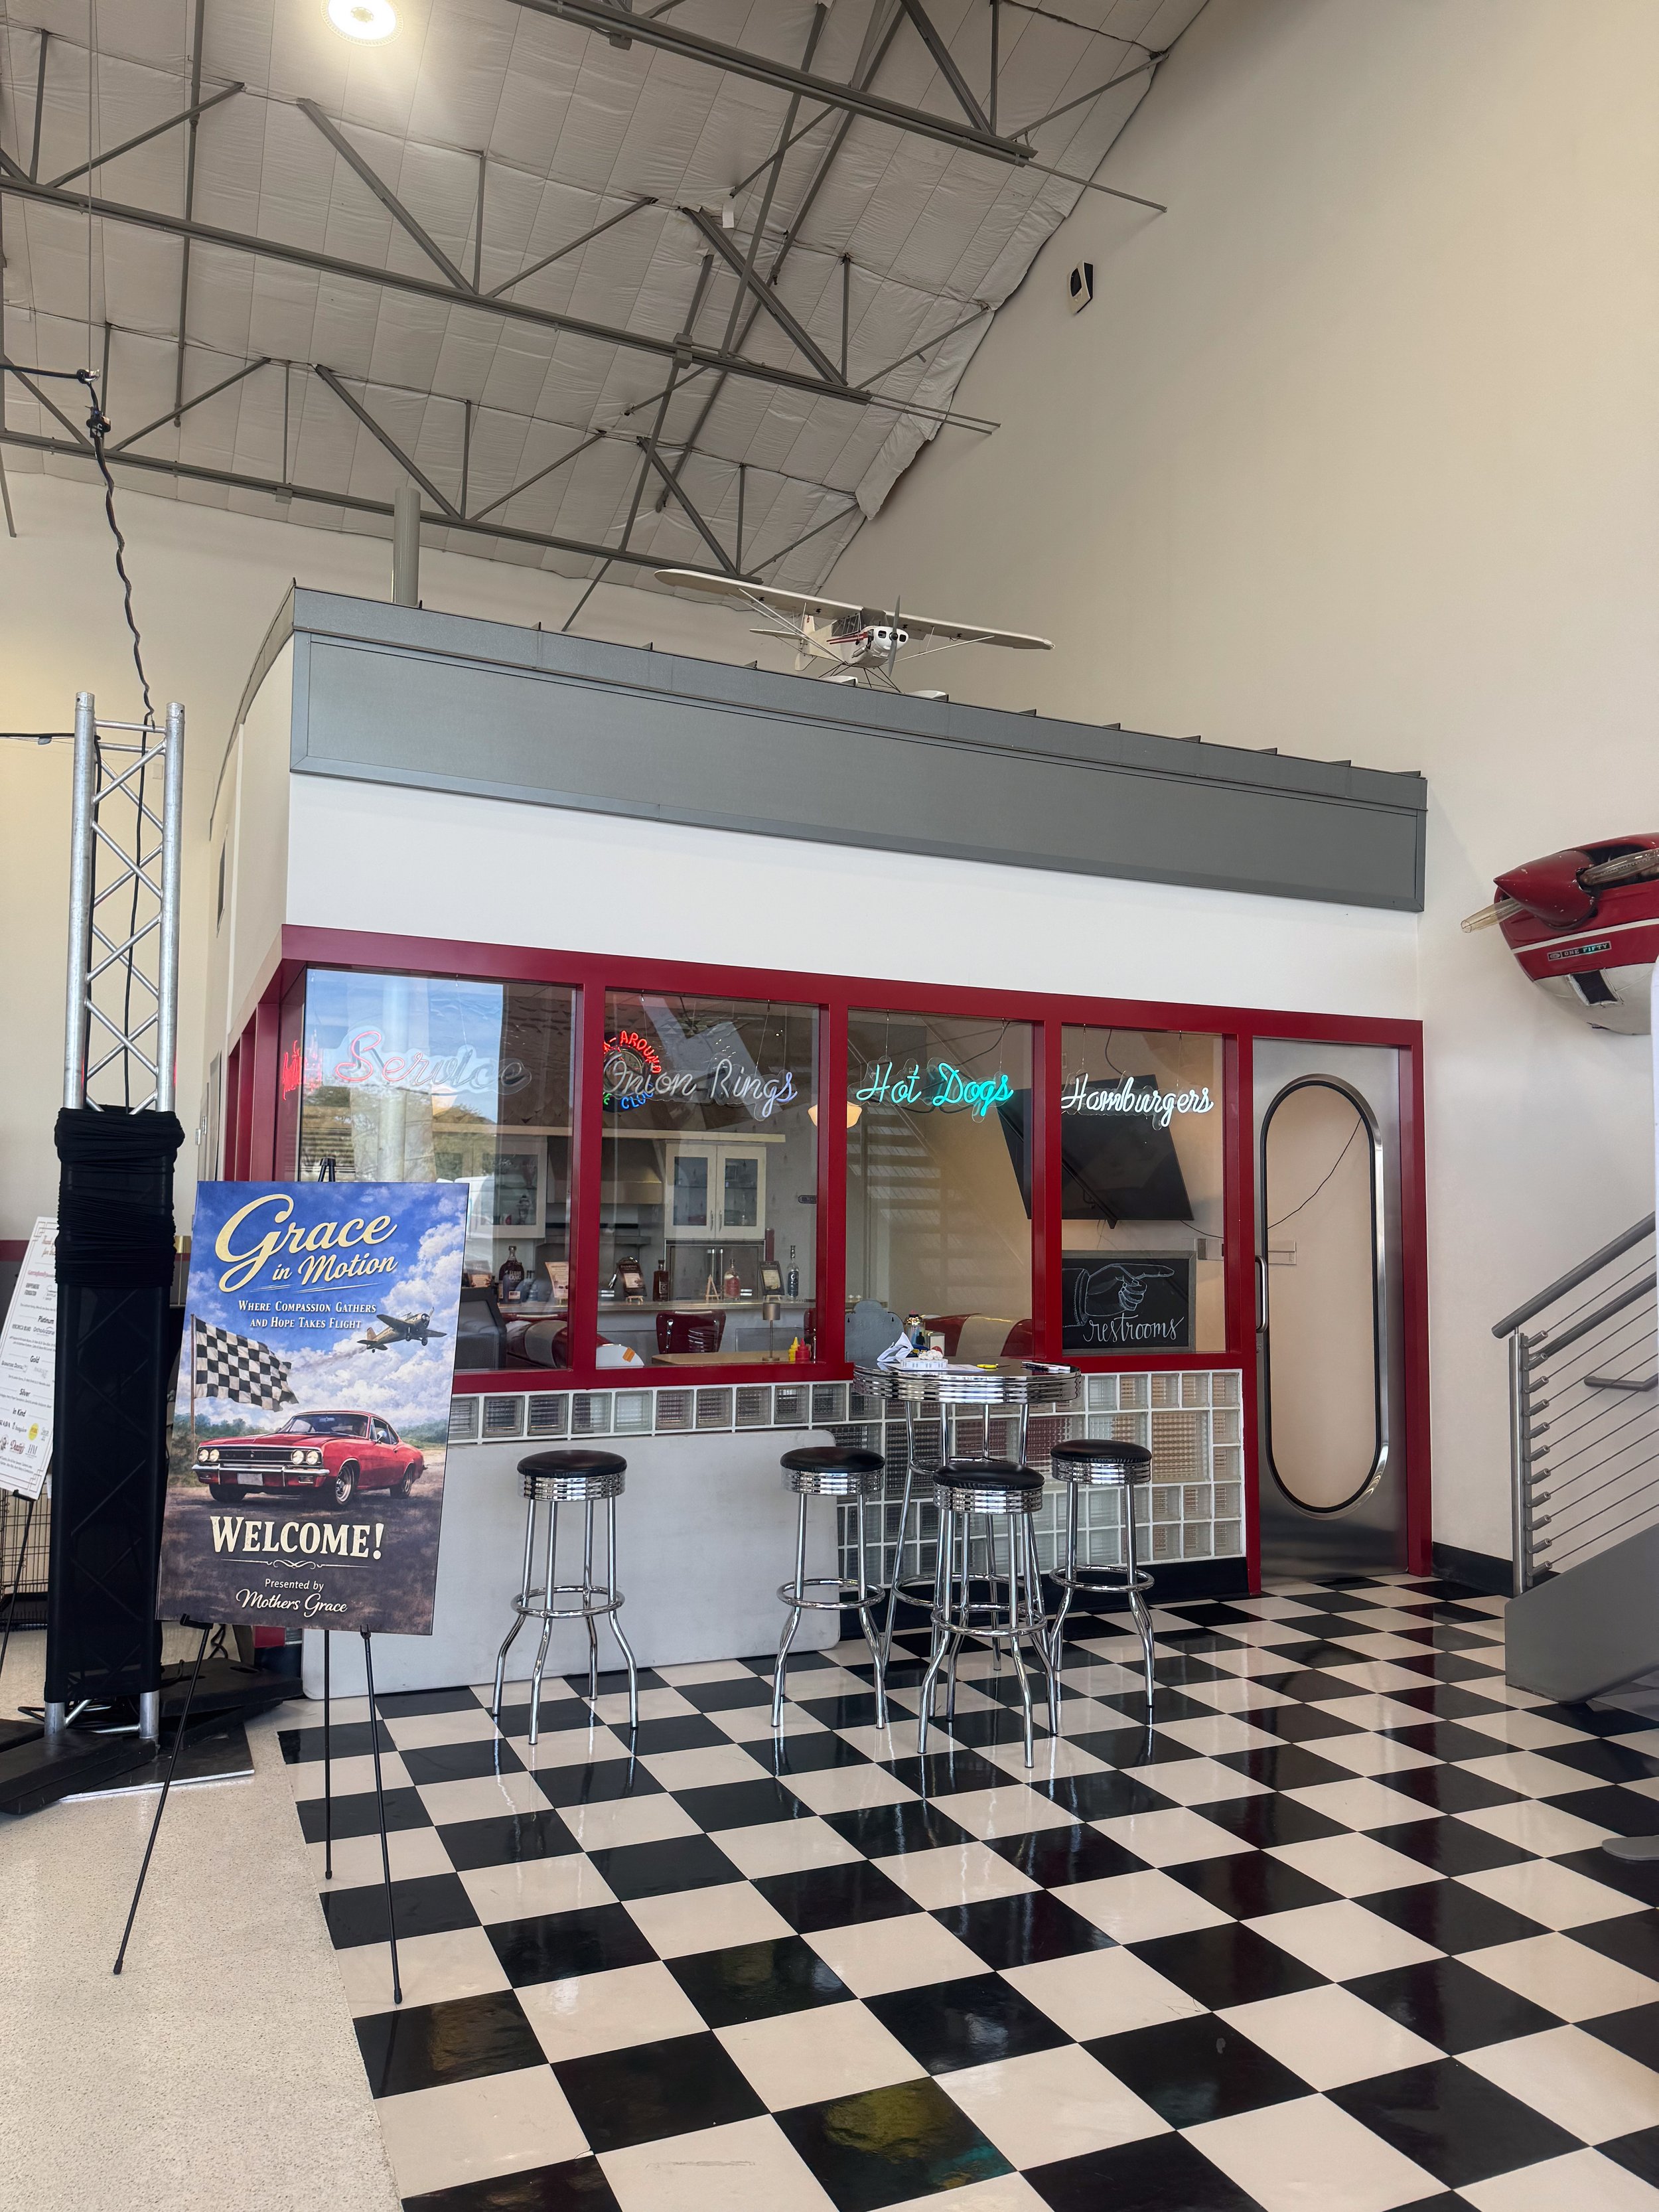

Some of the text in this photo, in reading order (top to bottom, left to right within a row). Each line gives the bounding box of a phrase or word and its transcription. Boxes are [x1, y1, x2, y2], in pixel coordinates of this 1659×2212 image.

[1583, 944, 1608, 953] FIFTY
[334, 1030, 526, 1086] Service
[603, 1053, 798, 1118] Onion Rings
[855, 1061, 1014, 1117] Hot Dogs
[1060, 1072, 1214, 1128] Hamburgers
[214, 1193, 398, 1293] Grace
[272, 1252, 399, 1286] in Motion
[238, 1299, 377, 1313] WHERE COMPASSION GATHERS
[270, 1316, 295, 1328] HOPE
[299, 1317, 326, 1329] TAKES
[329, 1317, 362, 1329] FLIGHT
[1083, 1312, 1185, 1343] restrooms
[210, 1515, 385, 1560] WELCOME!
[265, 1578, 325, 1593] Presented by
[236, 1588, 348, 1618] Mothers Grace
